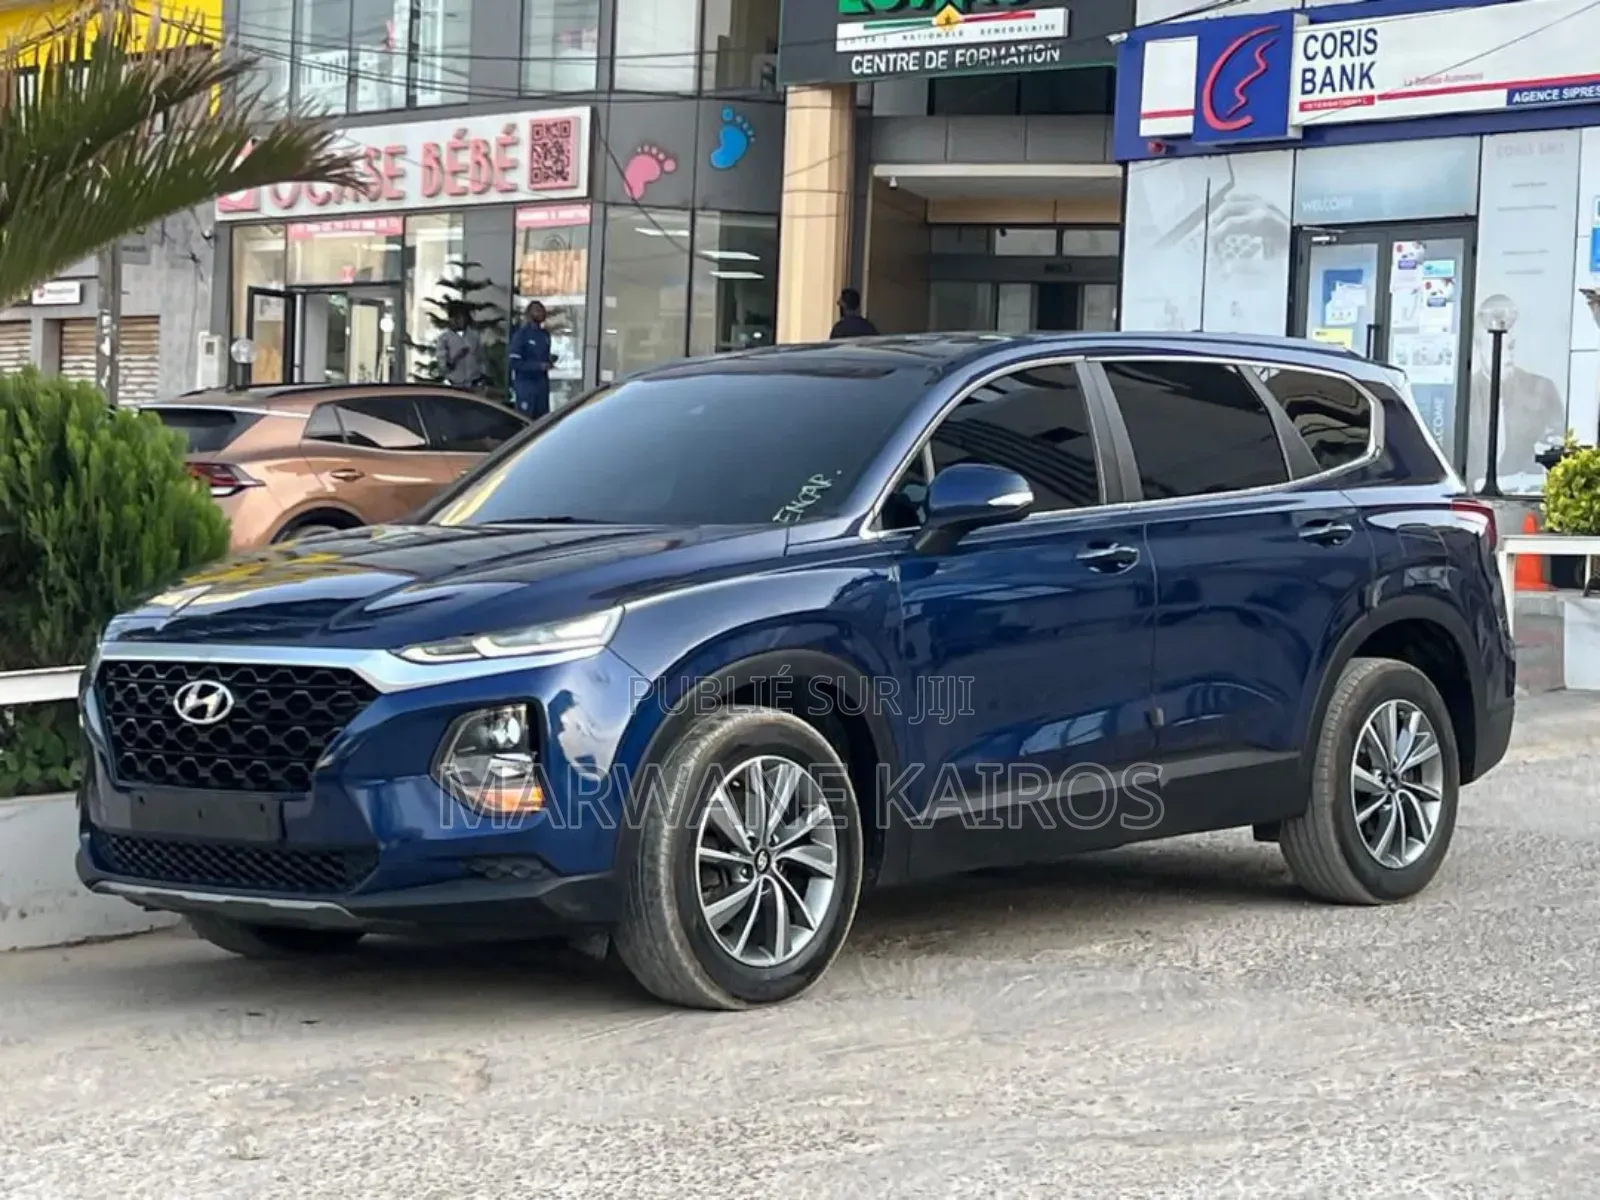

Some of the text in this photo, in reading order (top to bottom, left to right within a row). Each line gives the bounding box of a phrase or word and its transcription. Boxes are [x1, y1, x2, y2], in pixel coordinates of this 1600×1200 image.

[851, 43, 1060, 75] CENTRE DE FORMATION
[1303, 27, 1378, 61] CORIS
[1301, 61, 1376, 95] BANK
[1512, 88, 1560, 104] AGENCE
[421, 123, 520, 198] BÉBÉ
